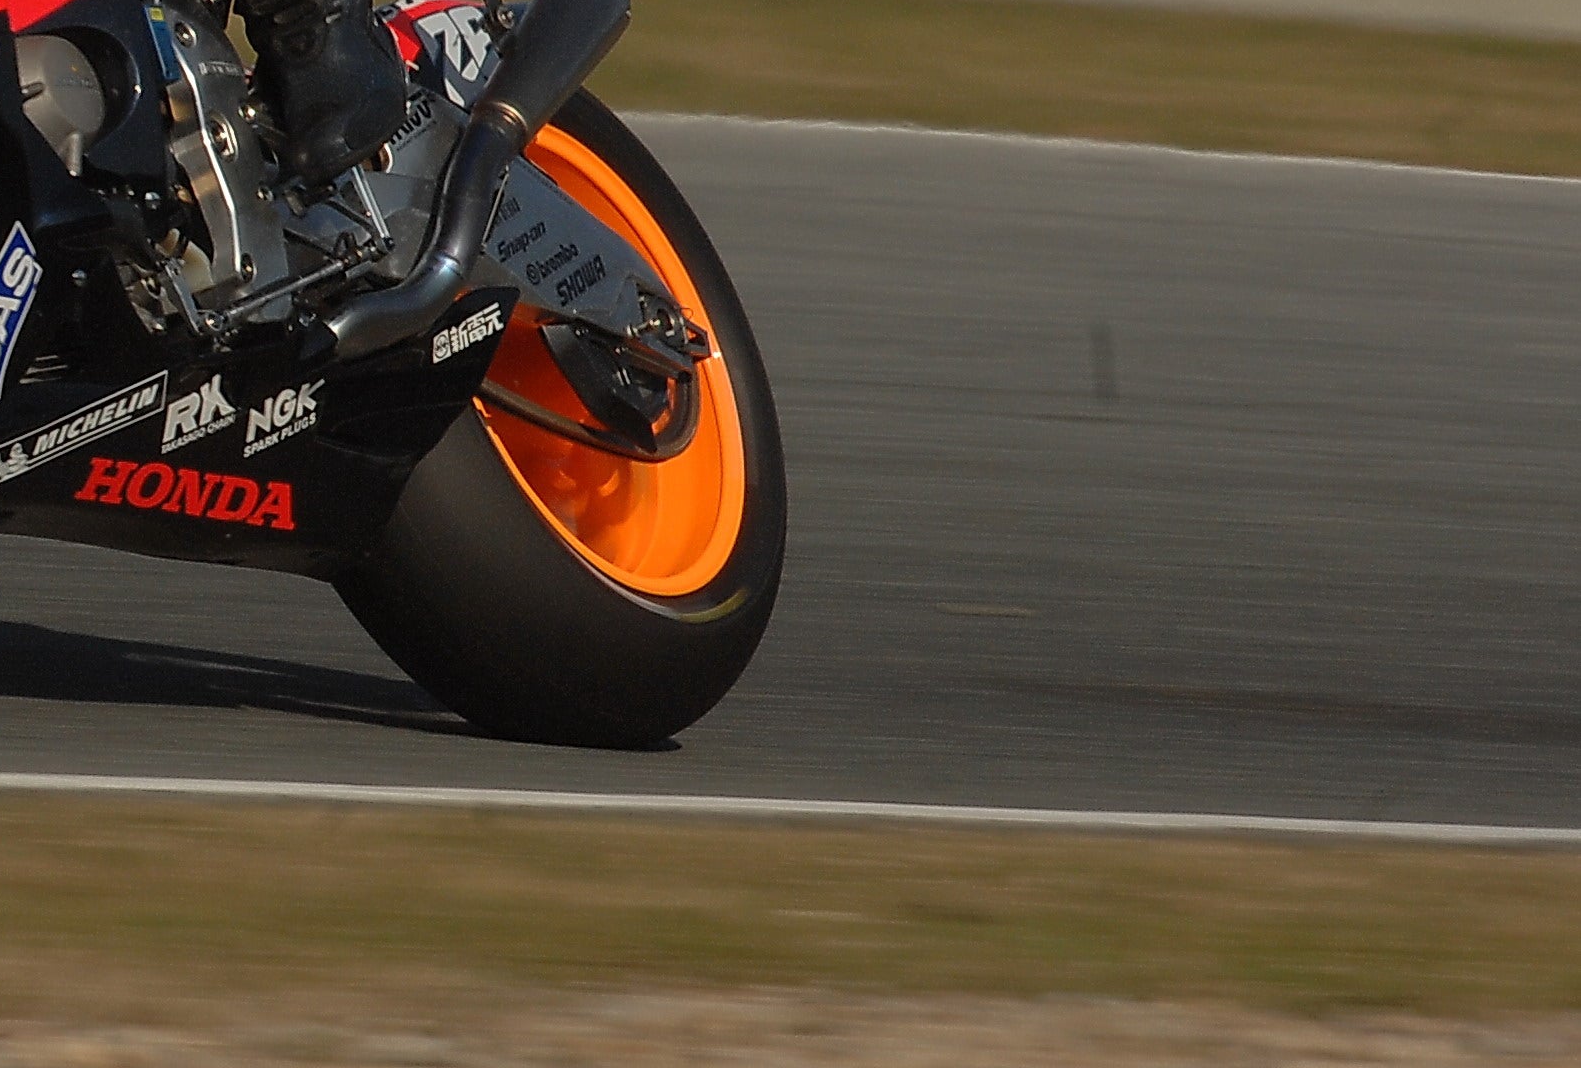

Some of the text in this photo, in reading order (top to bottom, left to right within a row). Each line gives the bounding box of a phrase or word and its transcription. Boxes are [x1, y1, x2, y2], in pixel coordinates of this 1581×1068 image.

[556, 254, 607, 307] SHOWA
[32, 383, 160, 457] MICHELIN
[161, 373, 237, 444] RK
[242, 411, 318, 459] SPARK PLUGS
[245, 378, 326, 444] NGK
[73, 456, 297, 531] HONDA
